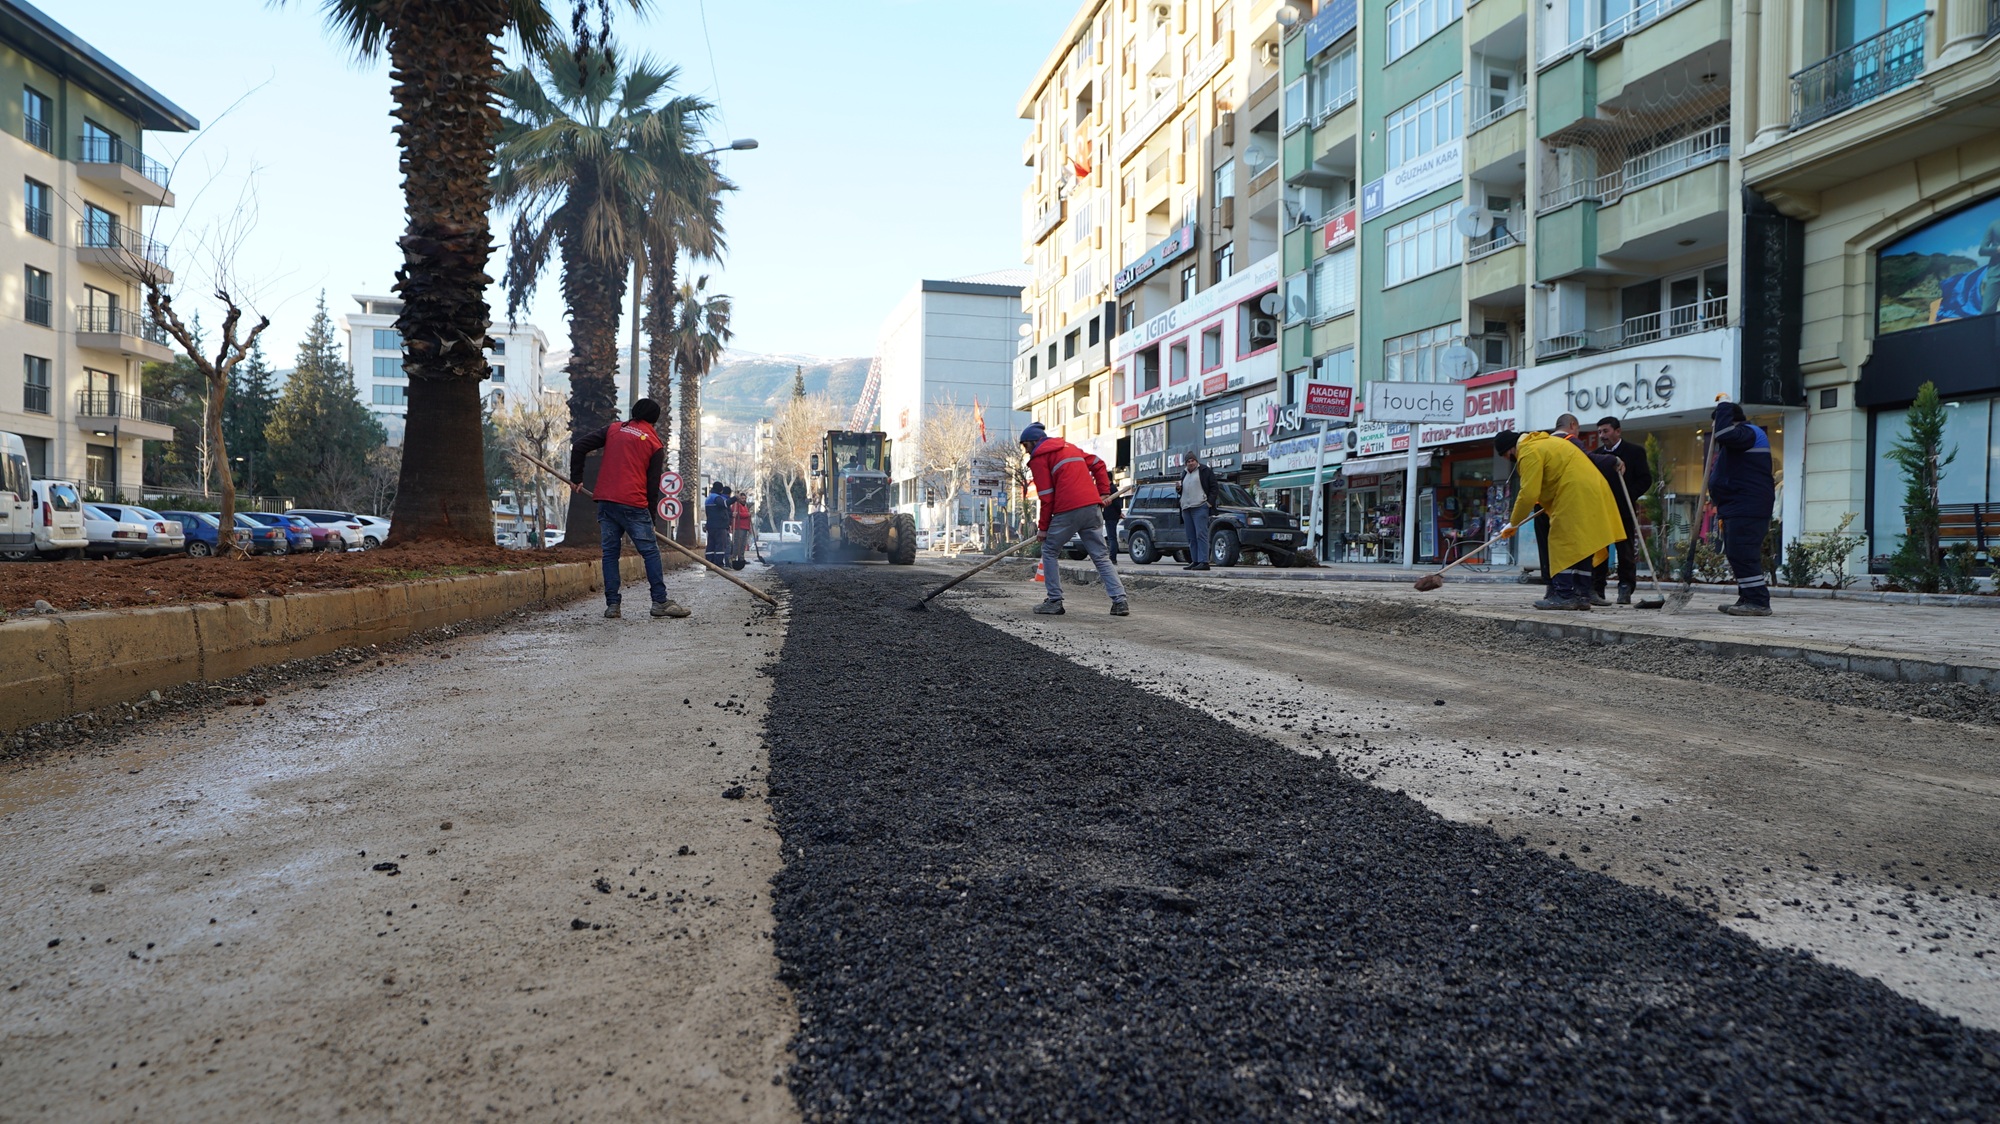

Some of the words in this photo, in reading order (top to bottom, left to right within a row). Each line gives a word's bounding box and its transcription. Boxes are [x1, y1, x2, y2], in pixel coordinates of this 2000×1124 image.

[1395, 160, 1434, 185] OĞUZHAN
[1435, 148, 1458, 166] KARA
[1310, 387, 1349, 399] AKADEMİ
[1383, 388, 1454, 412] touché
[1465, 382, 1515, 418] DEMİ
[1565, 364, 1676, 412] touché
[1307, 403, 1349, 416] FOTOKOPİ
[1312, 396, 1346, 406] KIRTASİYE
[1360, 432, 1385, 442] MOPAK
[1422, 417, 1515, 443] KİTAP-KIRTASİYE
